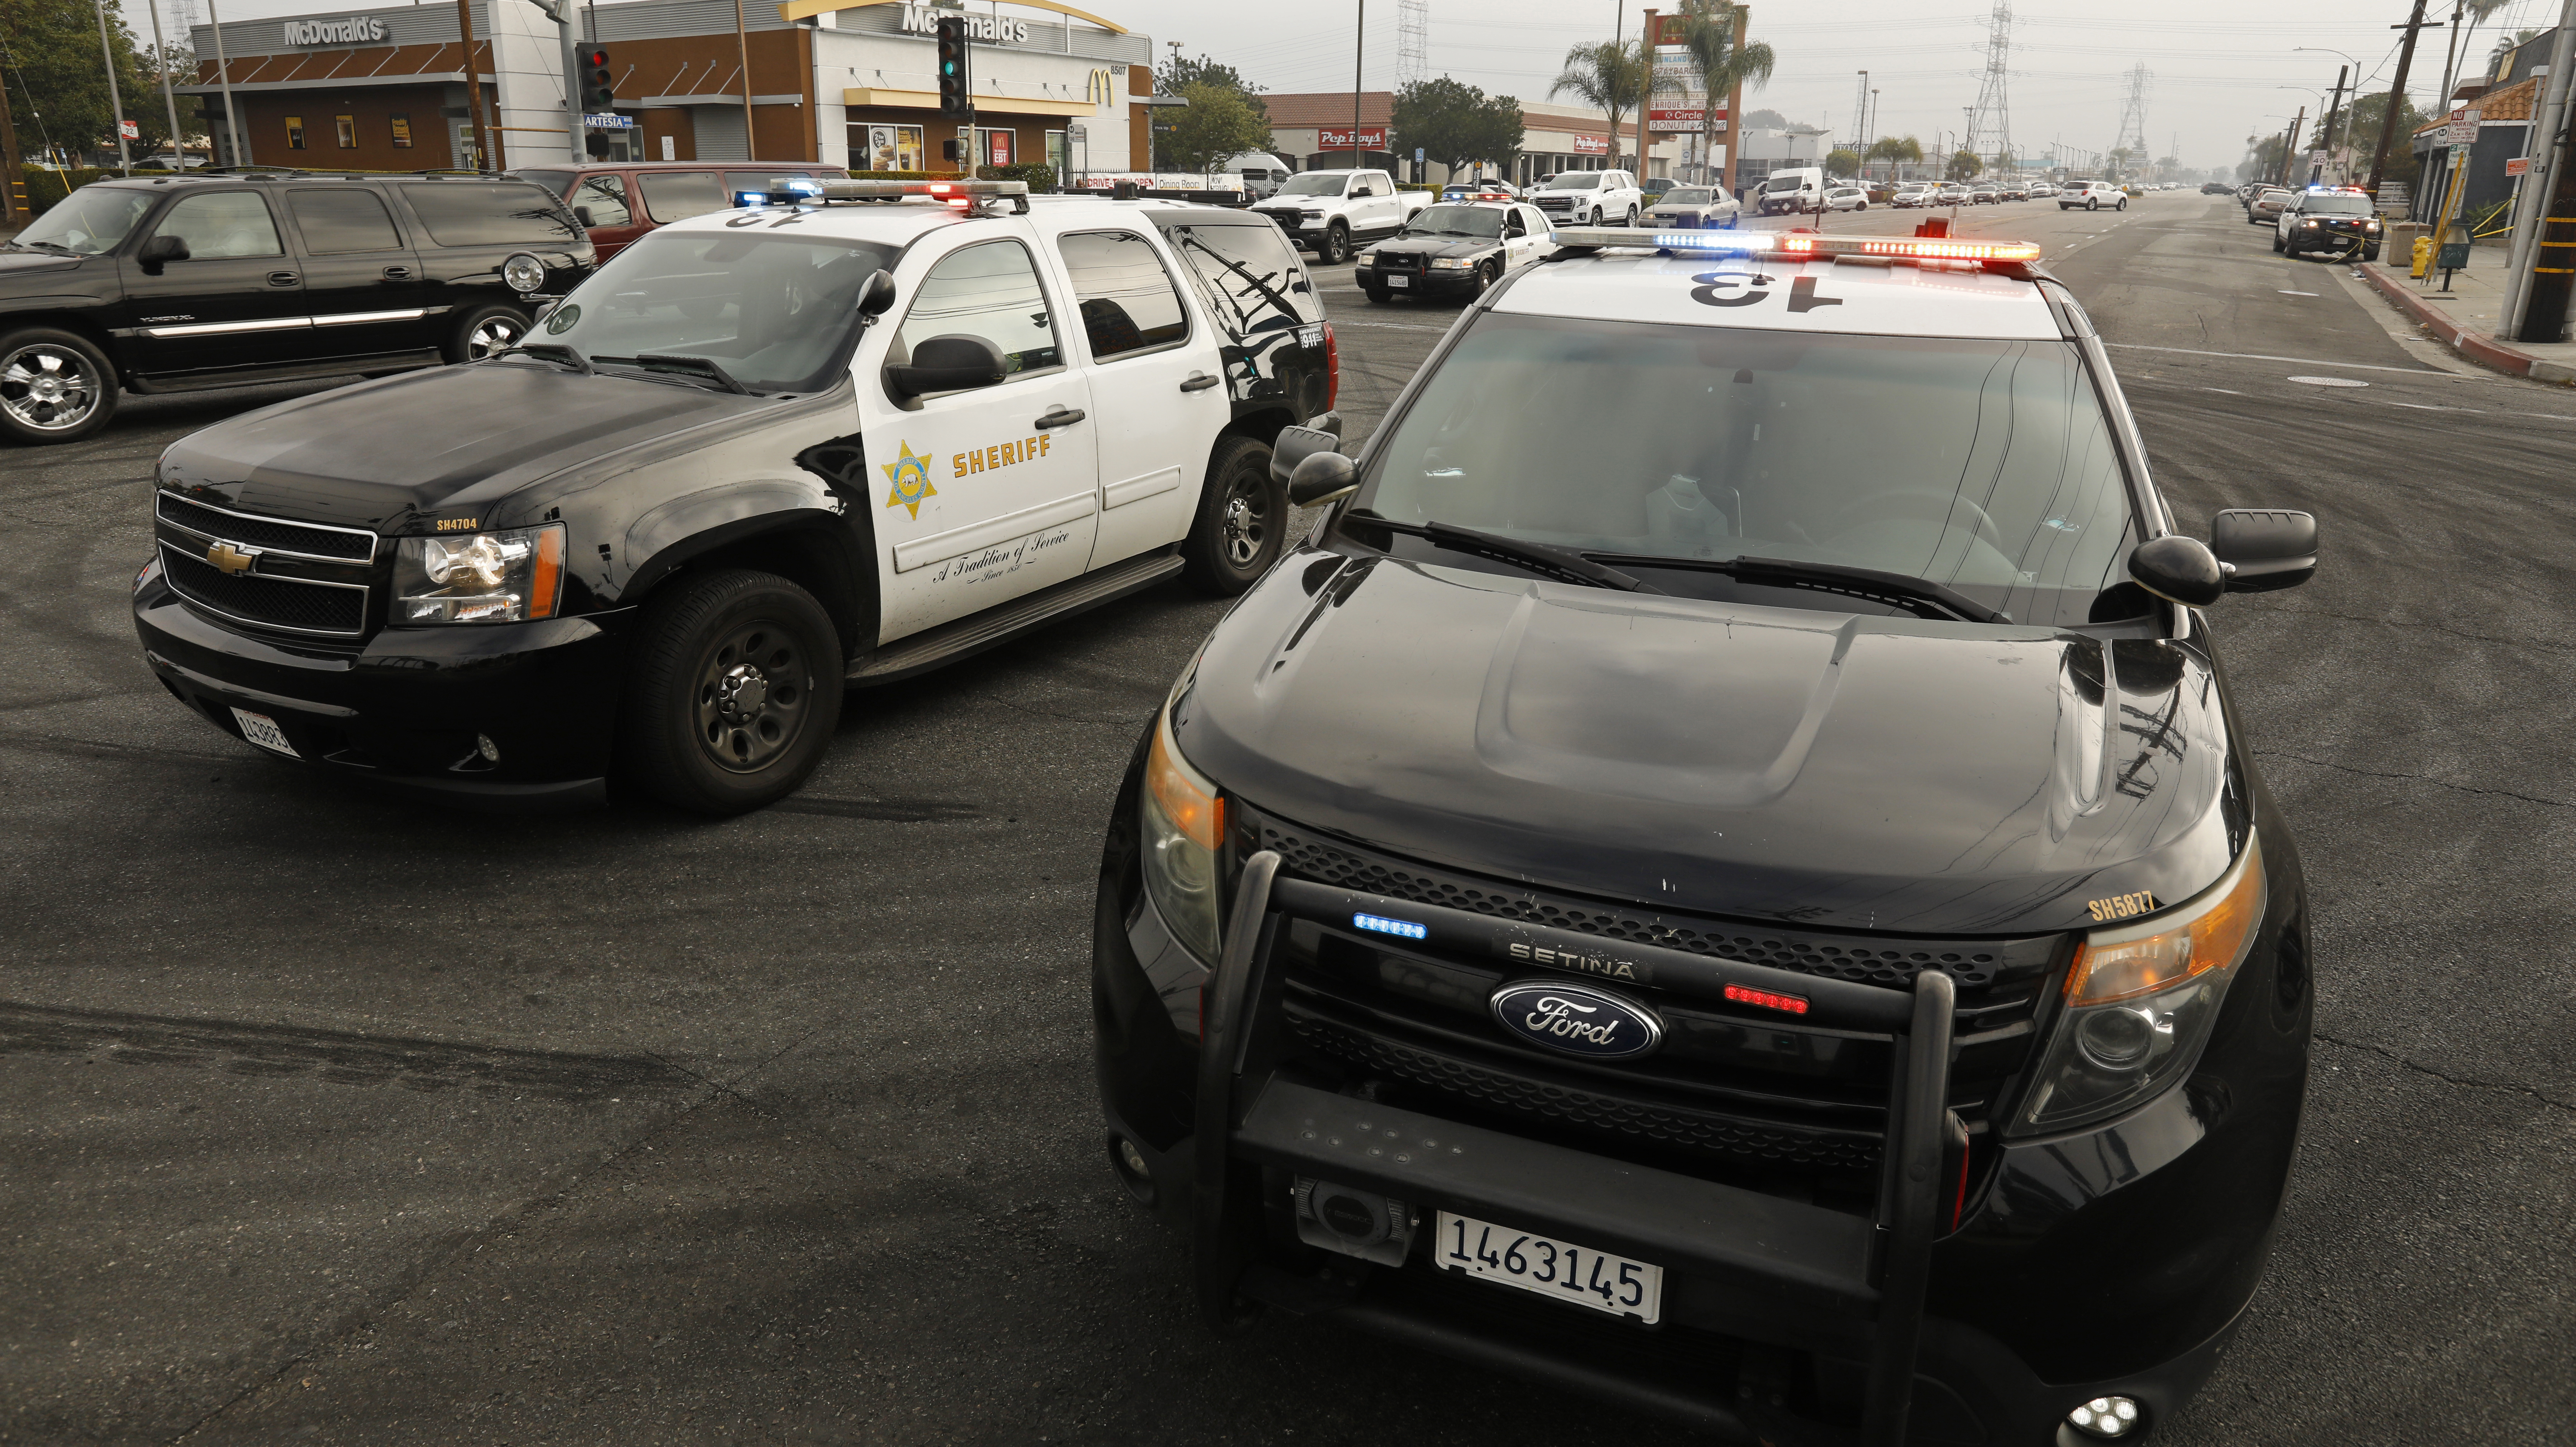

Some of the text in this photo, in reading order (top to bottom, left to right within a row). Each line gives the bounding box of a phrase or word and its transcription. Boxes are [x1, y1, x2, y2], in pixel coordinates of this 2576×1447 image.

[284, 17, 383, 45] McDonald's
[903, 5, 1028, 42] Mcnald's
[1111, 65, 1126, 75] 8507
[585, 116, 623, 127] ARTESIA
[2453, 111, 2463, 119] NO
[1321, 132, 1347, 145] Pep
[1575, 136, 1586, 149] Pep
[994, 153, 1007, 163] EBT
[1134, 178, 1154, 187] OPEN
[1159, 179, 1200, 190] Dining Room
[1690, 272, 1844, 313] 13
[1299, 326, 1321, 335] EMERGENCY
[897, 458, 918, 470] SHERIFF
[953, 434, 1050, 478] SHERIFF
[898, 492, 918, 503] ANGELES
[918, 472, 926, 496] COUNTY
[437, 518, 477, 531] SH4704
[933, 530, 1069, 583] A Tradition of Service
[981, 563, 1022, 582] Since 1850
[2088, 890, 2155, 922] SH5877
[1510, 943, 1637, 981] SETINA
[1526, 996, 1620, 1046] Ford
[1450, 1220, 1644, 1307] 1463145
